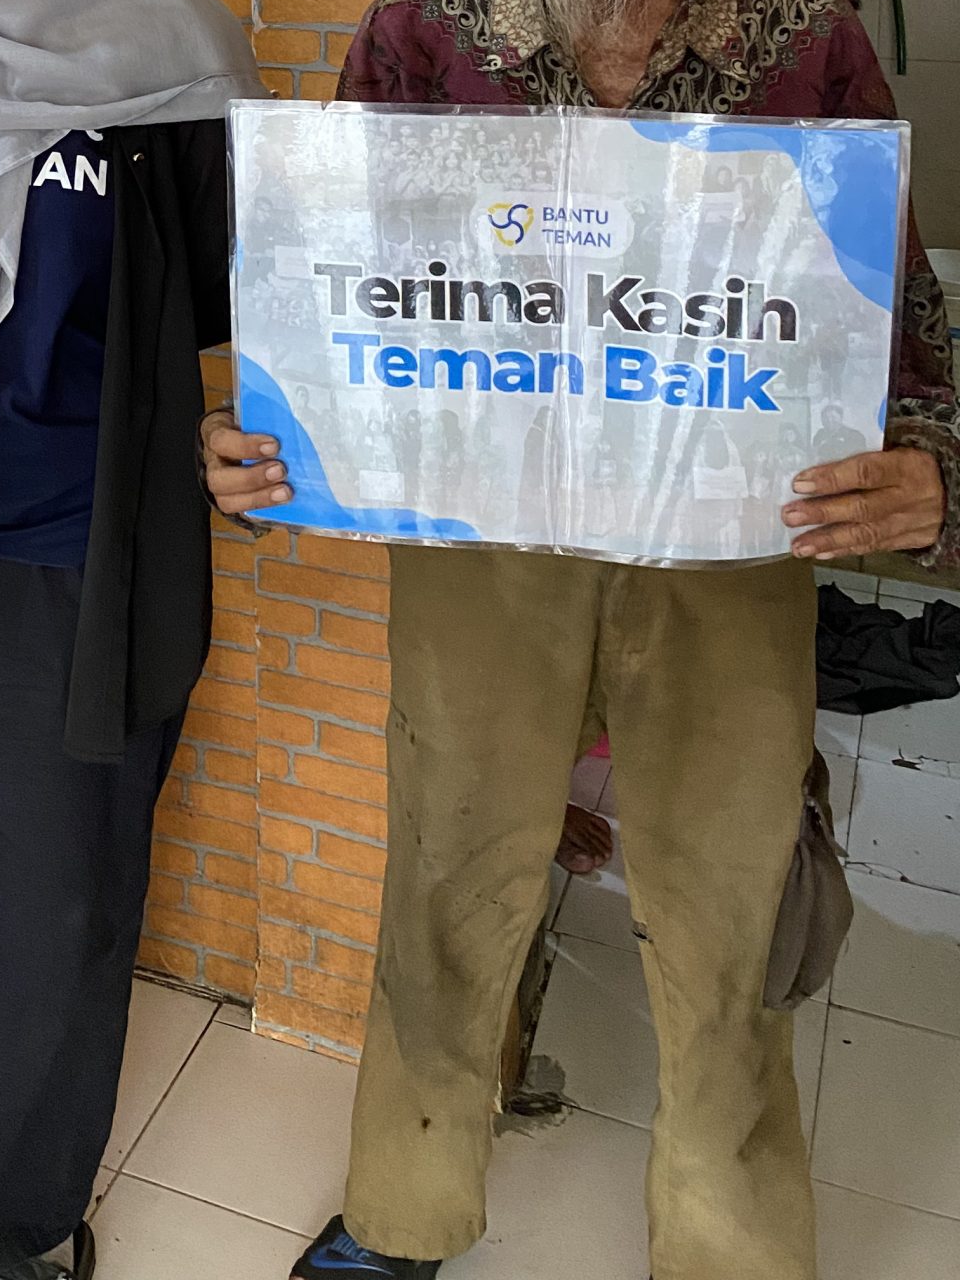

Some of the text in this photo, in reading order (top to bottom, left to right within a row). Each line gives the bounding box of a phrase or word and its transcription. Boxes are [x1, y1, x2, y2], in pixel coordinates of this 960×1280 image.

[30, 151, 108, 197] AN
[542, 207, 609, 225] BANTU
[542, 228, 611, 248] TEMAN
[314, 261, 798, 343] Terima Kasih
[332, 331, 781, 413] Teman Baik
